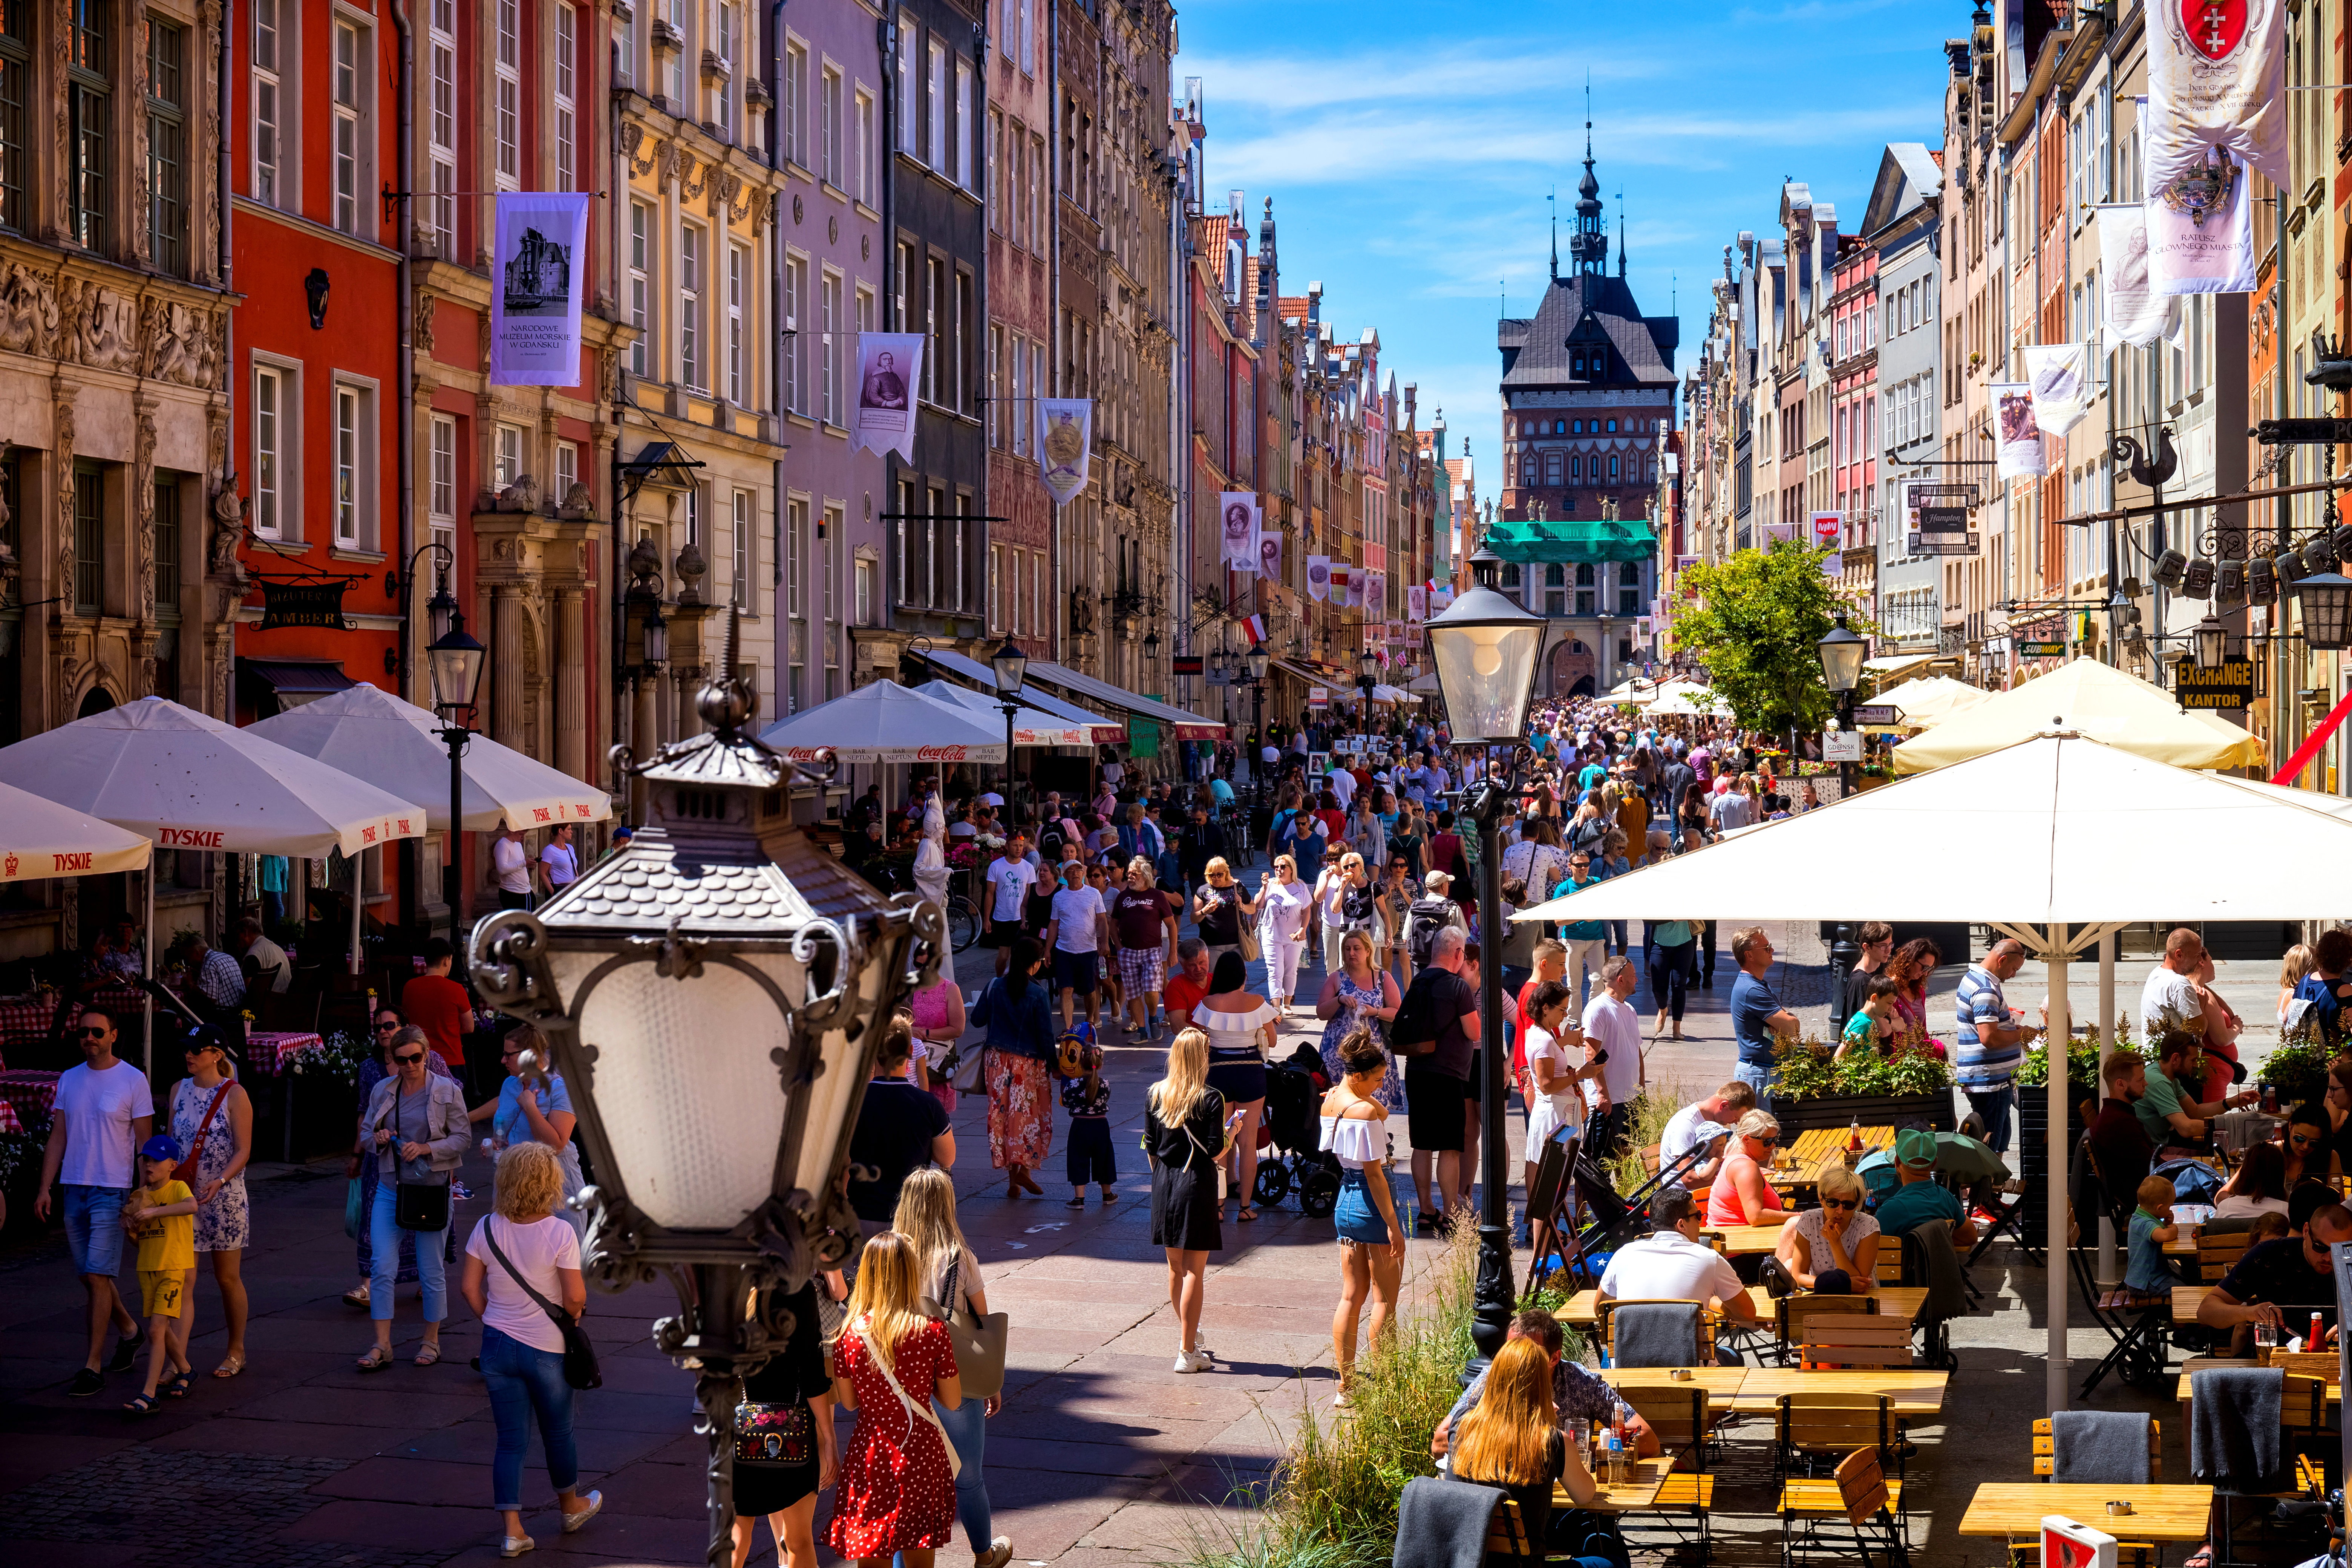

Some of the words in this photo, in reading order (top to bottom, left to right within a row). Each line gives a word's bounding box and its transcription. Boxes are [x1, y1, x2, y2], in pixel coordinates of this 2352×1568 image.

[2155, 243, 2208, 254] GŁÓWNEGO
[2210, 242, 2244, 251] MIASTA
[1925, 513, 1964, 524] Hampton
[2023, 644, 2064, 654] SUBWAY
[2179, 663, 2251, 686] EXCHANGE
[2185, 694, 2240, 707] KANTOR
[917, 744, 970, 761] Coca-Cola
[532, 807, 551, 822] TYSKIE
[575, 804, 591, 817] TYSKIE
[362, 825, 376, 844] TYSKIE
[398, 819, 410, 835] TYSKIE
[158, 827, 225, 848] TYSKIE
[53, 852, 92, 871] TYSKIE
